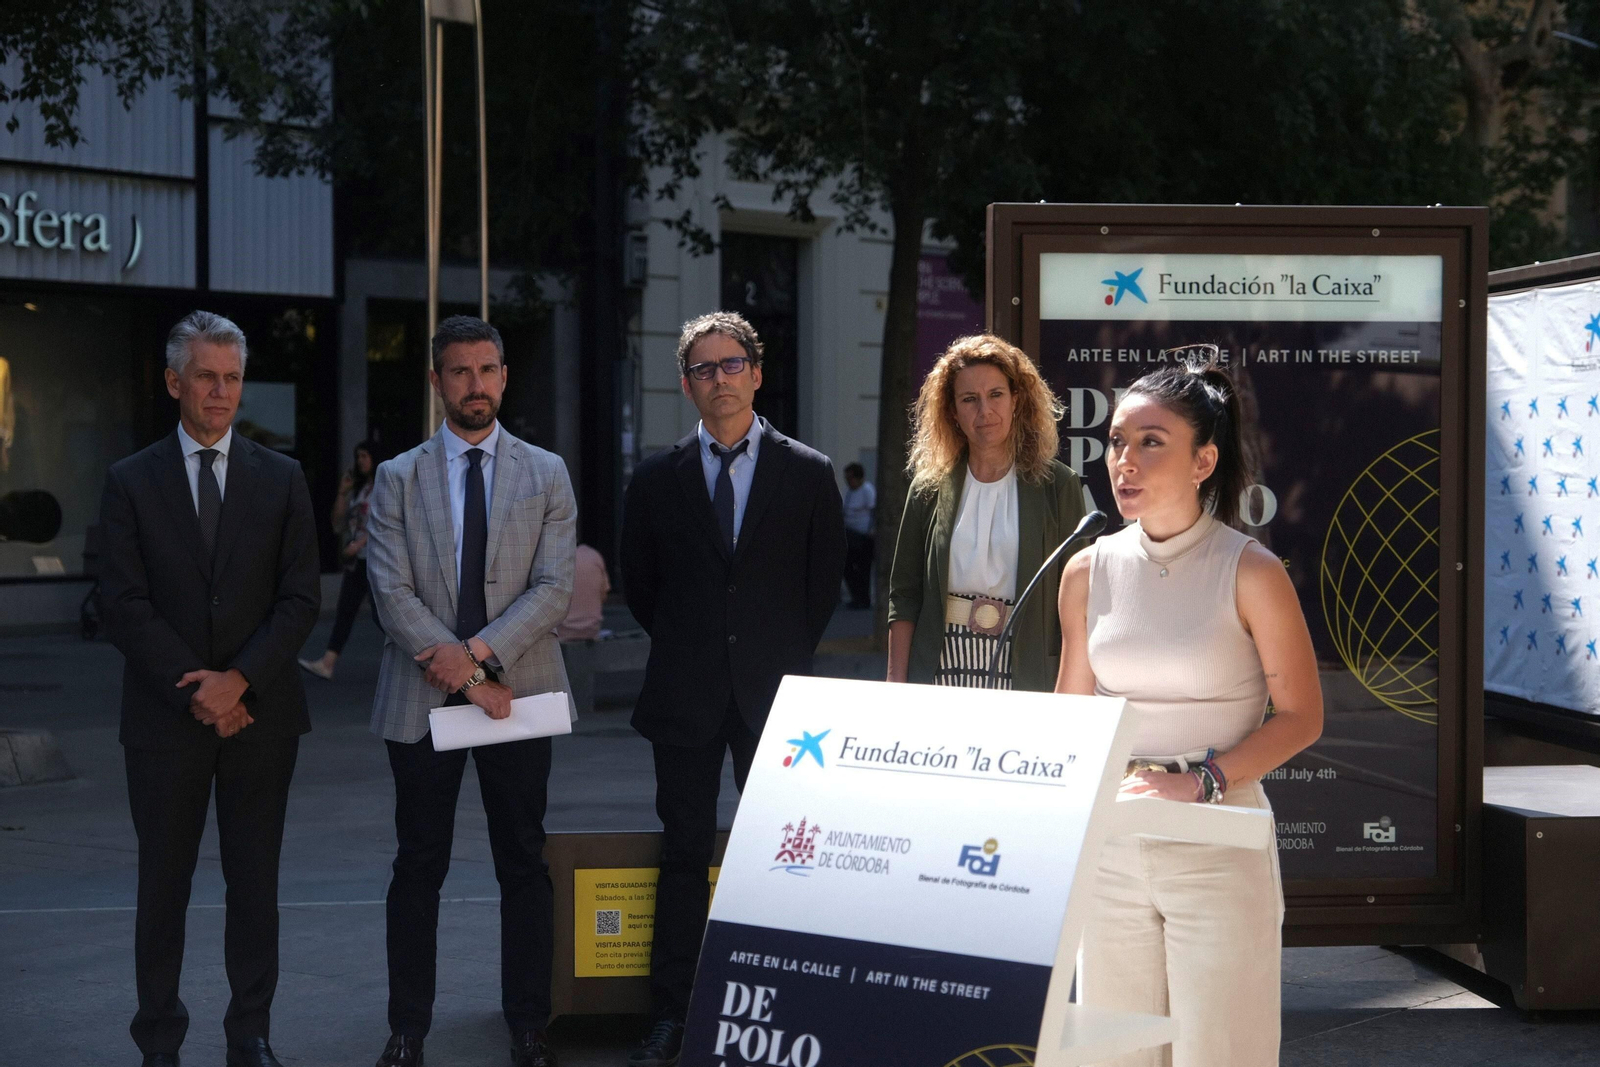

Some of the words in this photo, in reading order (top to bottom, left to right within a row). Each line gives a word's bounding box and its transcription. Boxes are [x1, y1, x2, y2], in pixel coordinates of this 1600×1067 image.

[1158, 273, 1275, 296] Fundación
[1067, 348, 1112, 362] ARTE
[1117, 348, 1140, 362] EN
[1146, 348, 1168, 362] LA
[1256, 349, 1290, 363] ART
[1295, 349, 1313, 363] IN
[1317, 349, 1351, 363] THE
[1356, 349, 1421, 364] STREET
[837, 736, 959, 770] Fundación
[1289, 767, 1314, 783] July
[1316, 767, 1337, 780] 4th
[824, 830, 912, 855] AYUNTAMIENTO
[818, 851, 834, 868] DE
[835, 850, 890, 875] CÓRDOBA
[595, 894, 628, 902] Sábados,
[595, 941, 622, 949] VISITAS
[595, 951, 609, 959] Con
[623, 951, 644, 959] previa
[729, 950, 761, 967] ARTE
[762, 955, 780, 969] EN
[782, 958, 798, 972] LA
[801, 961, 842, 978] CALLE
[865, 970, 892, 986] ART
[893, 974, 909, 988] IN
[912, 977, 938, 993] THE
[940, 981, 992, 1000] STREET
[719, 980, 778, 1023] DE
[712, 1020, 822, 1067] POLO
